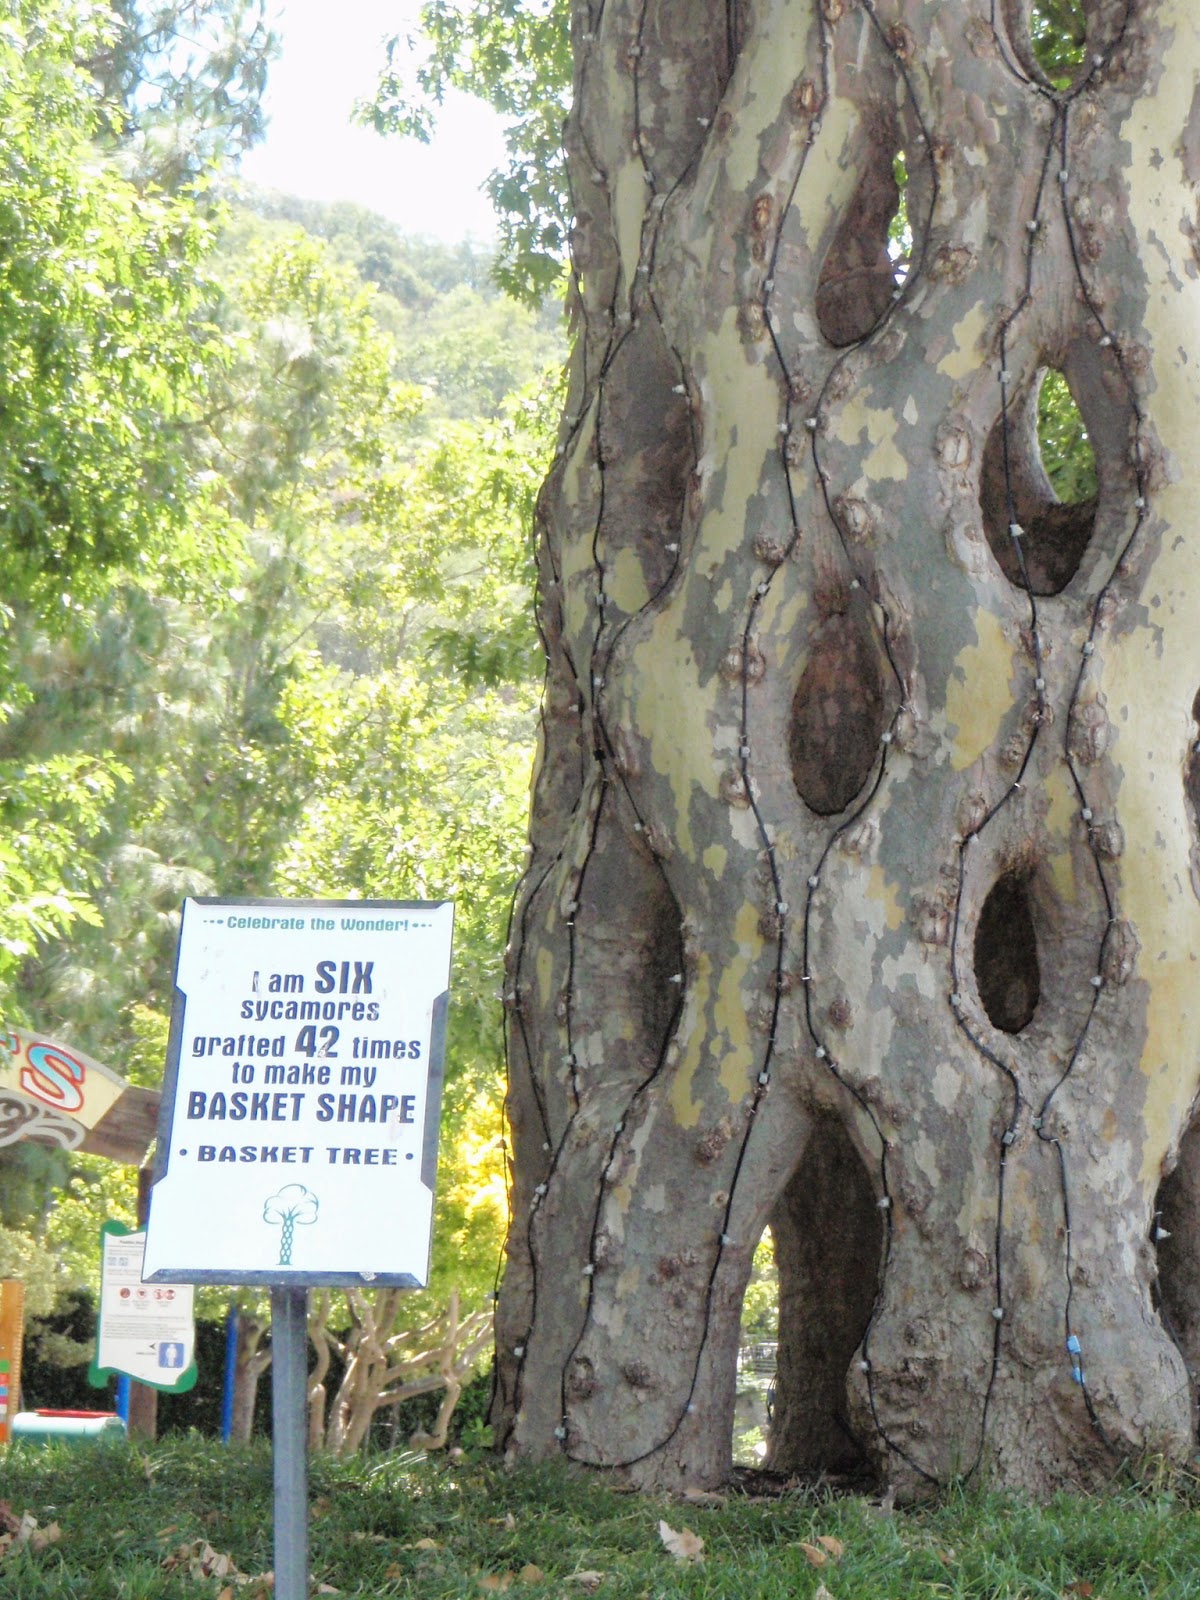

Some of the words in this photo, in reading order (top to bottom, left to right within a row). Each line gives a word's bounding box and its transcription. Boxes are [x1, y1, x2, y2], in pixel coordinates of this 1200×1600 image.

[227, 917, 304, 930] Celebrate
[311, 917, 335, 930] the
[340, 918, 408, 931] Wonder!
[252, 971, 260, 992] I
[268, 974, 304, 993] am
[315, 961, 375, 994] SIX
[241, 999, 380, 1021] sycamores
[192, 1035, 285, 1057] grafted
[294, 1025, 340, 1058] 42
[352, 1037, 421, 1059] times
[232, 1061, 254, 1084] to
[264, 1063, 330, 1085] make
[340, 1065, 377, 1088] my
[187, 1091, 305, 1121] BASKET
[316, 1094, 416, 1124] SHAPE
[197, 1145, 314, 1164] BASKET
[326, 1147, 397, 1165] TREE
